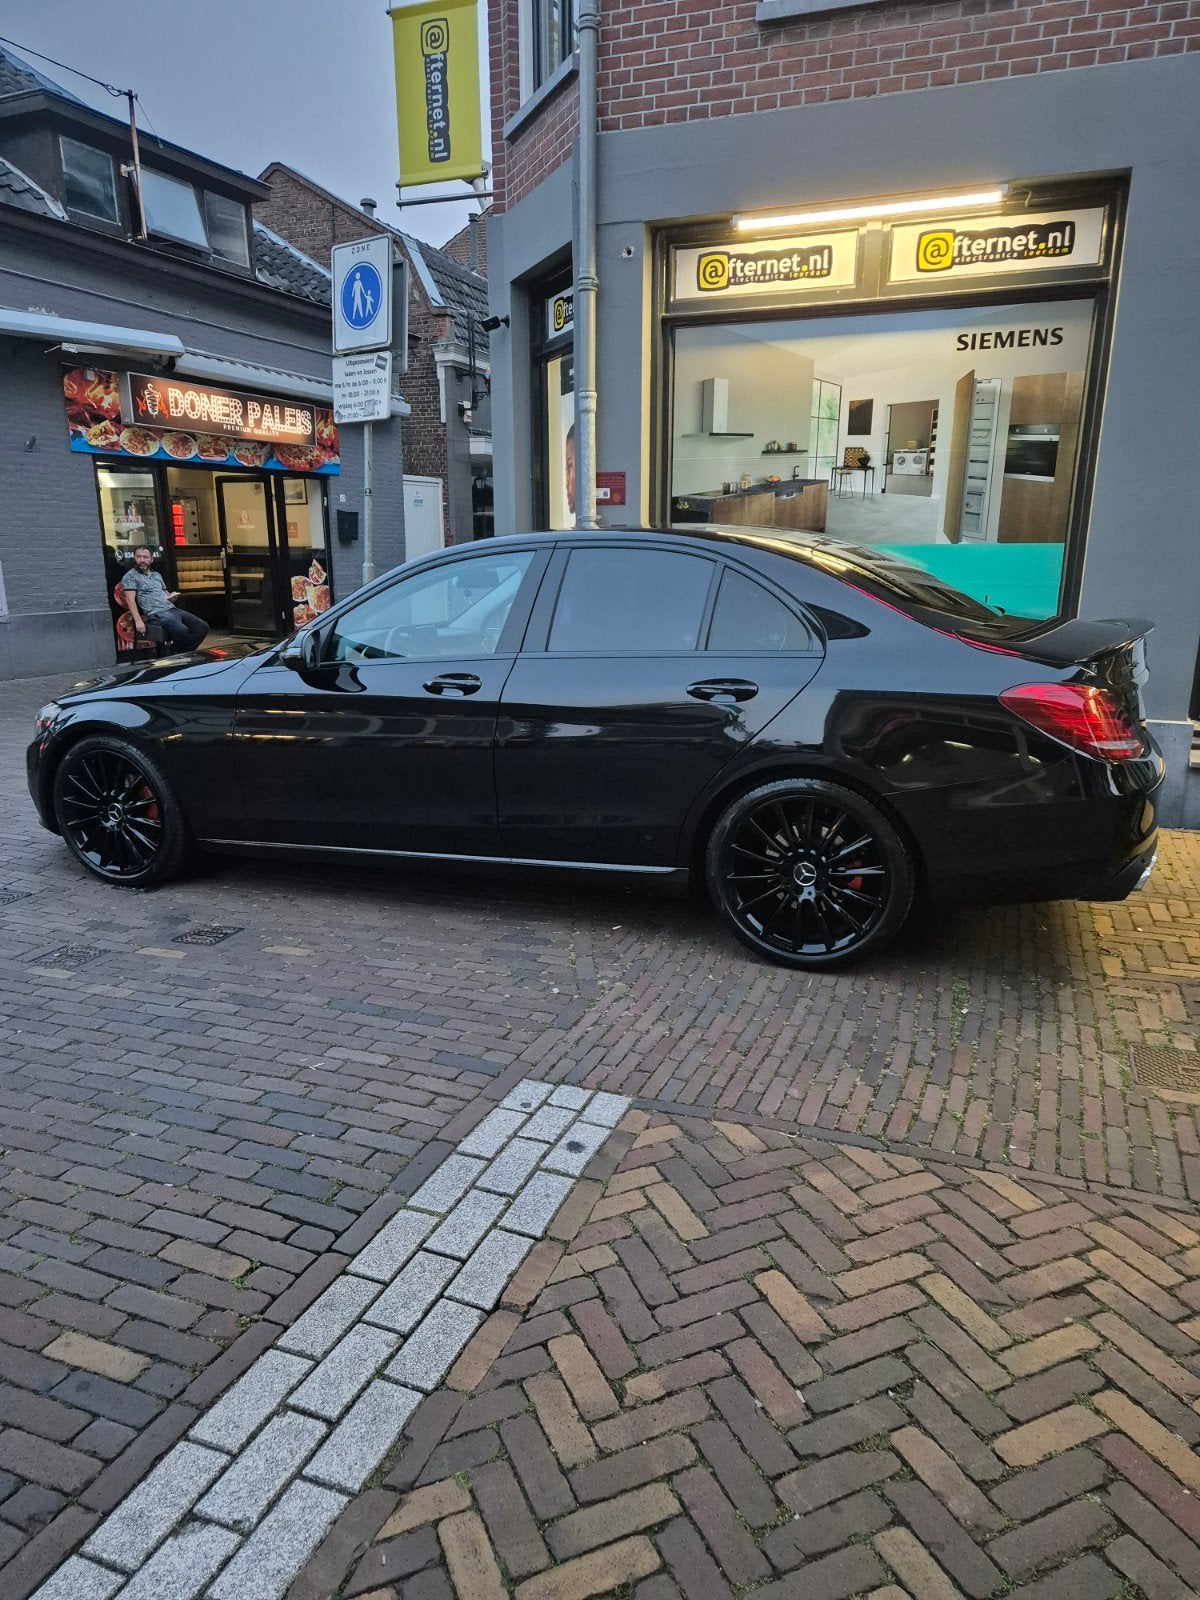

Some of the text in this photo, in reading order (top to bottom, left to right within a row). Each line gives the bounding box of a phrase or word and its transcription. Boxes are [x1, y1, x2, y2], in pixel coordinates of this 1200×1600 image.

[351, 243, 371, 255] ZONE
[923, 225, 1072, 266] @fternet.nl
[954, 247, 1069, 264] electronica leerdam
[702, 249, 830, 286] @fternet.nl
[730, 273, 785, 284] electronica
[956, 327, 1064, 351] SIEMENS
[167, 387, 313, 436] DONER PALEIS
[223, 424, 279, 437] PREMIUM QUALITY
